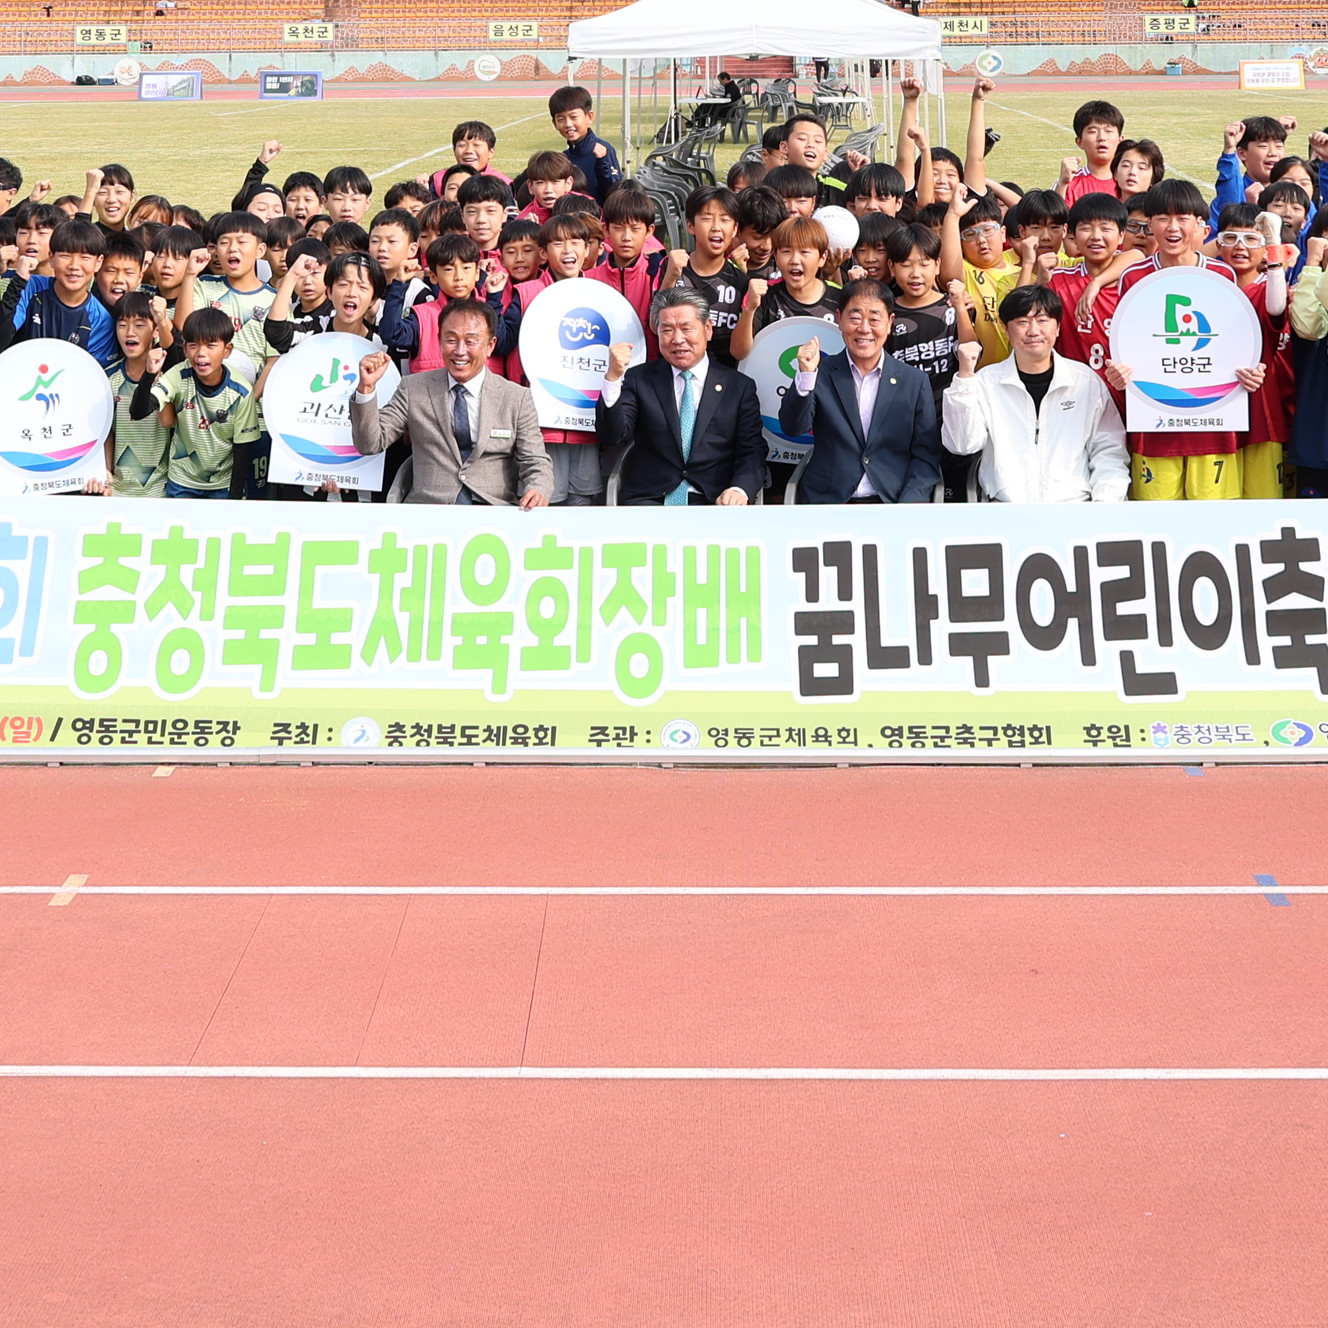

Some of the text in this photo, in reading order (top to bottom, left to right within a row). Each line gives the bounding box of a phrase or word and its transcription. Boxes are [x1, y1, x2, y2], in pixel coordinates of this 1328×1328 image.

[287, 25, 328, 38] 옥천군
[494, 24, 534, 37] 음성군
[943, 19, 983, 32] 제천시
[1149, 17, 1190, 30] 증평군
[80, 28, 122, 41] 영동군
[717, 285, 736, 304] 10
[560, 355, 608, 373] 진천군
[1089, 343, 1104, 370] 8
[1162, 356, 1212, 374] 단양군
[299, 401, 356, 420] 괴산
[1167, 418, 1224, 427] 충청북도체육회
[20, 423, 74, 441] 옥천군
[252, 456, 267, 480] 19
[1213, 460, 1224, 484] 7
[32, 477, 84, 491] 충청북도체육회
[73, 521, 762, 698] 충청북도체육회장배
[71, 718, 241, 748] 영동군민운동장
[270, 722, 319, 746] 주최
[385, 722, 557, 748] 충청북도체육회
[588, 725, 638, 748] 주관
[880, 723, 1052, 748] 영동군축구협회
[1083, 723, 1132, 748] 후원
